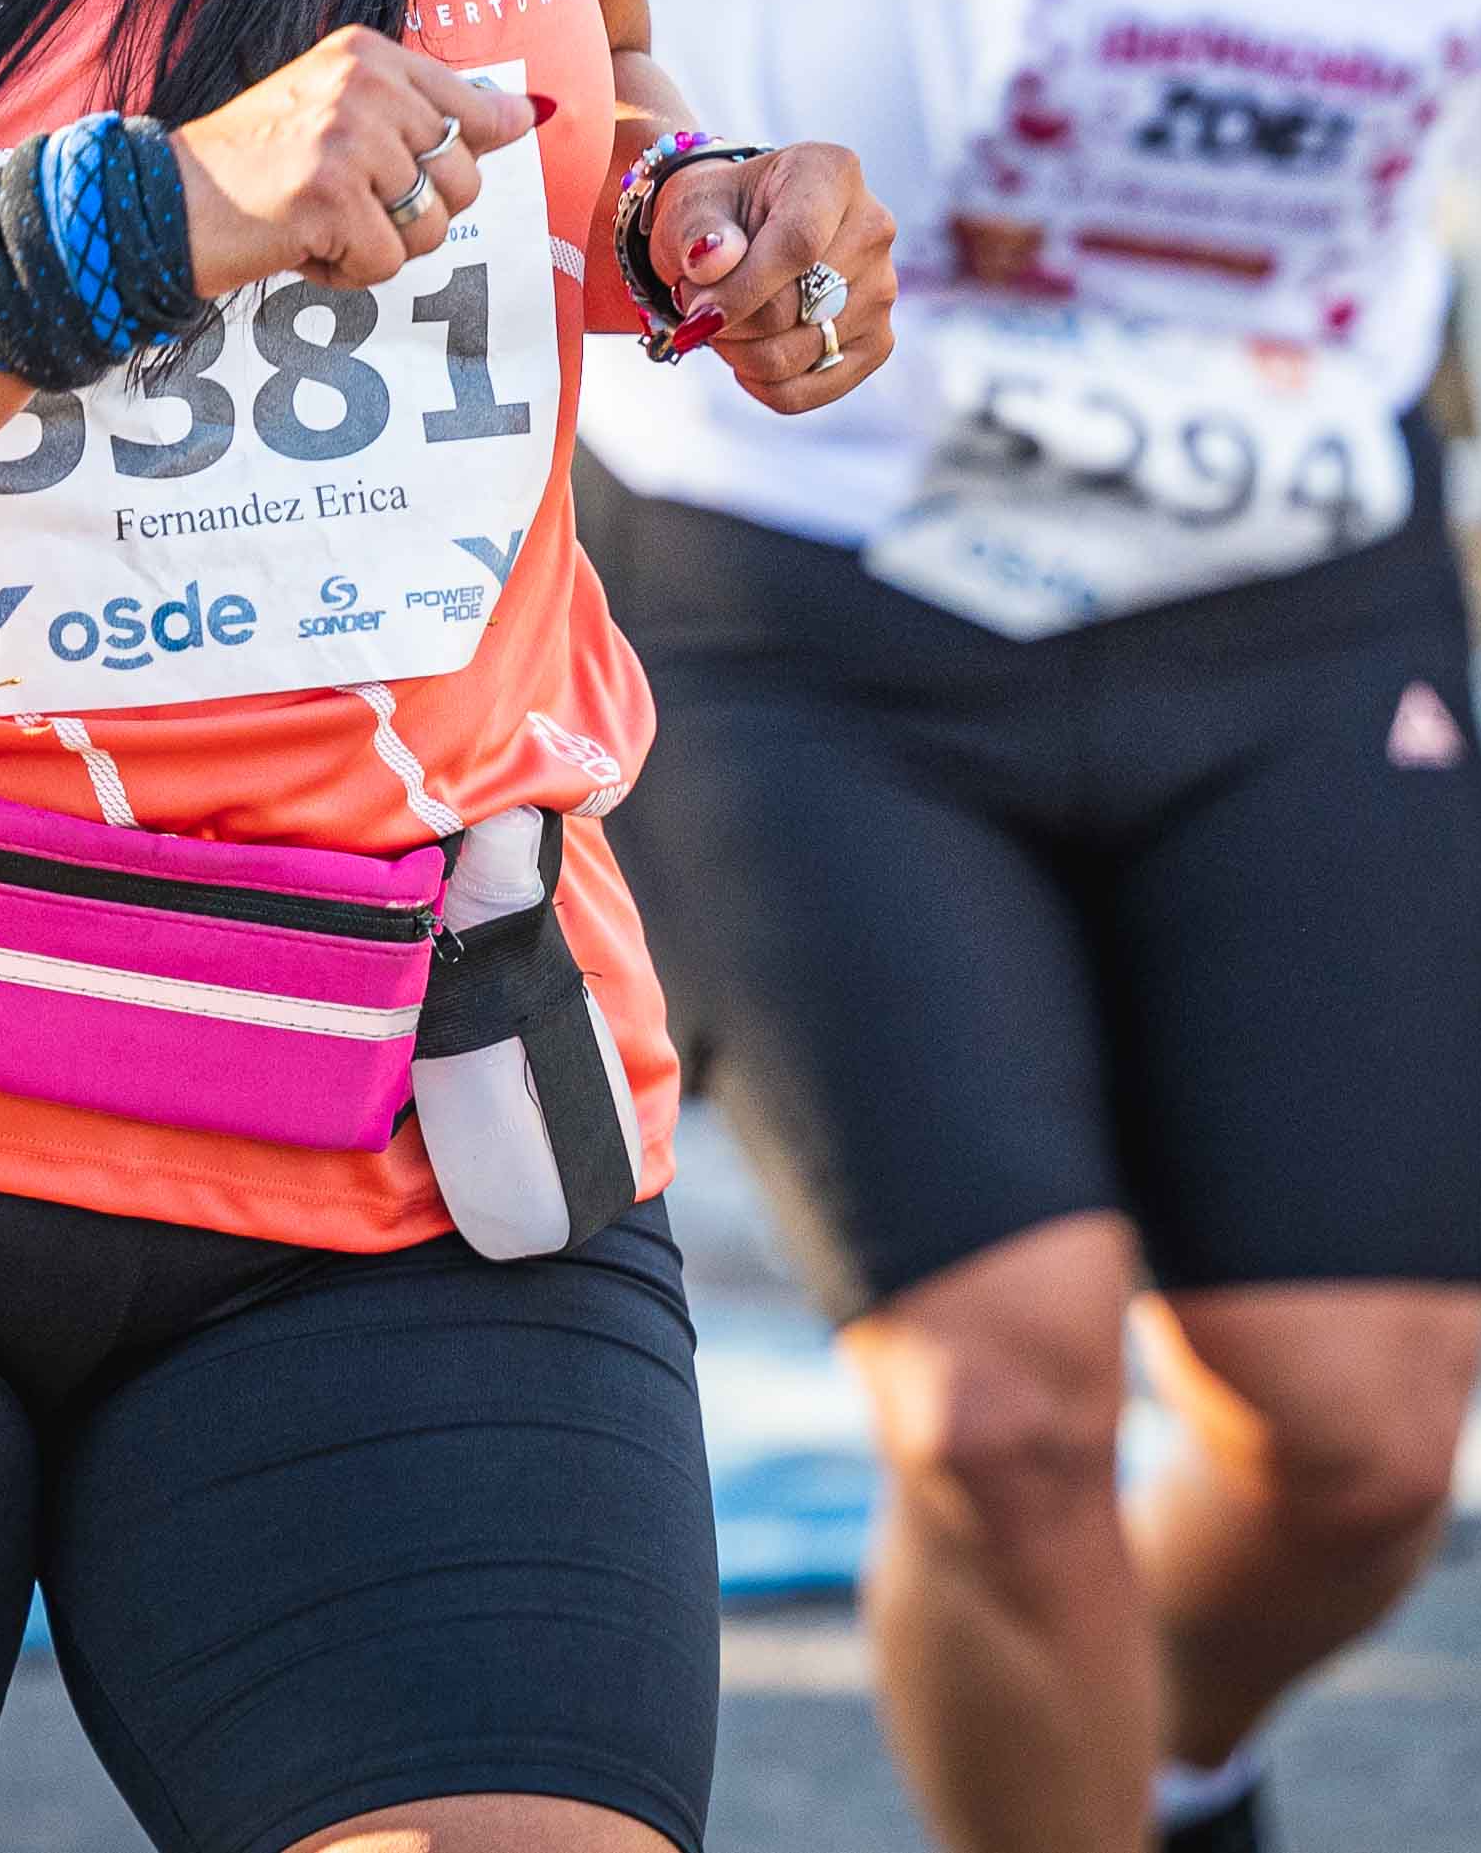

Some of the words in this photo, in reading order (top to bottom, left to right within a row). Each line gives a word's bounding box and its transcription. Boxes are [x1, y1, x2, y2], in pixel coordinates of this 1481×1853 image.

[114, 492, 305, 541] Fernandez
[312, 479, 409, 519] Erica
[48, 580, 258, 664] osde
[405, 586, 485, 609] POWER
